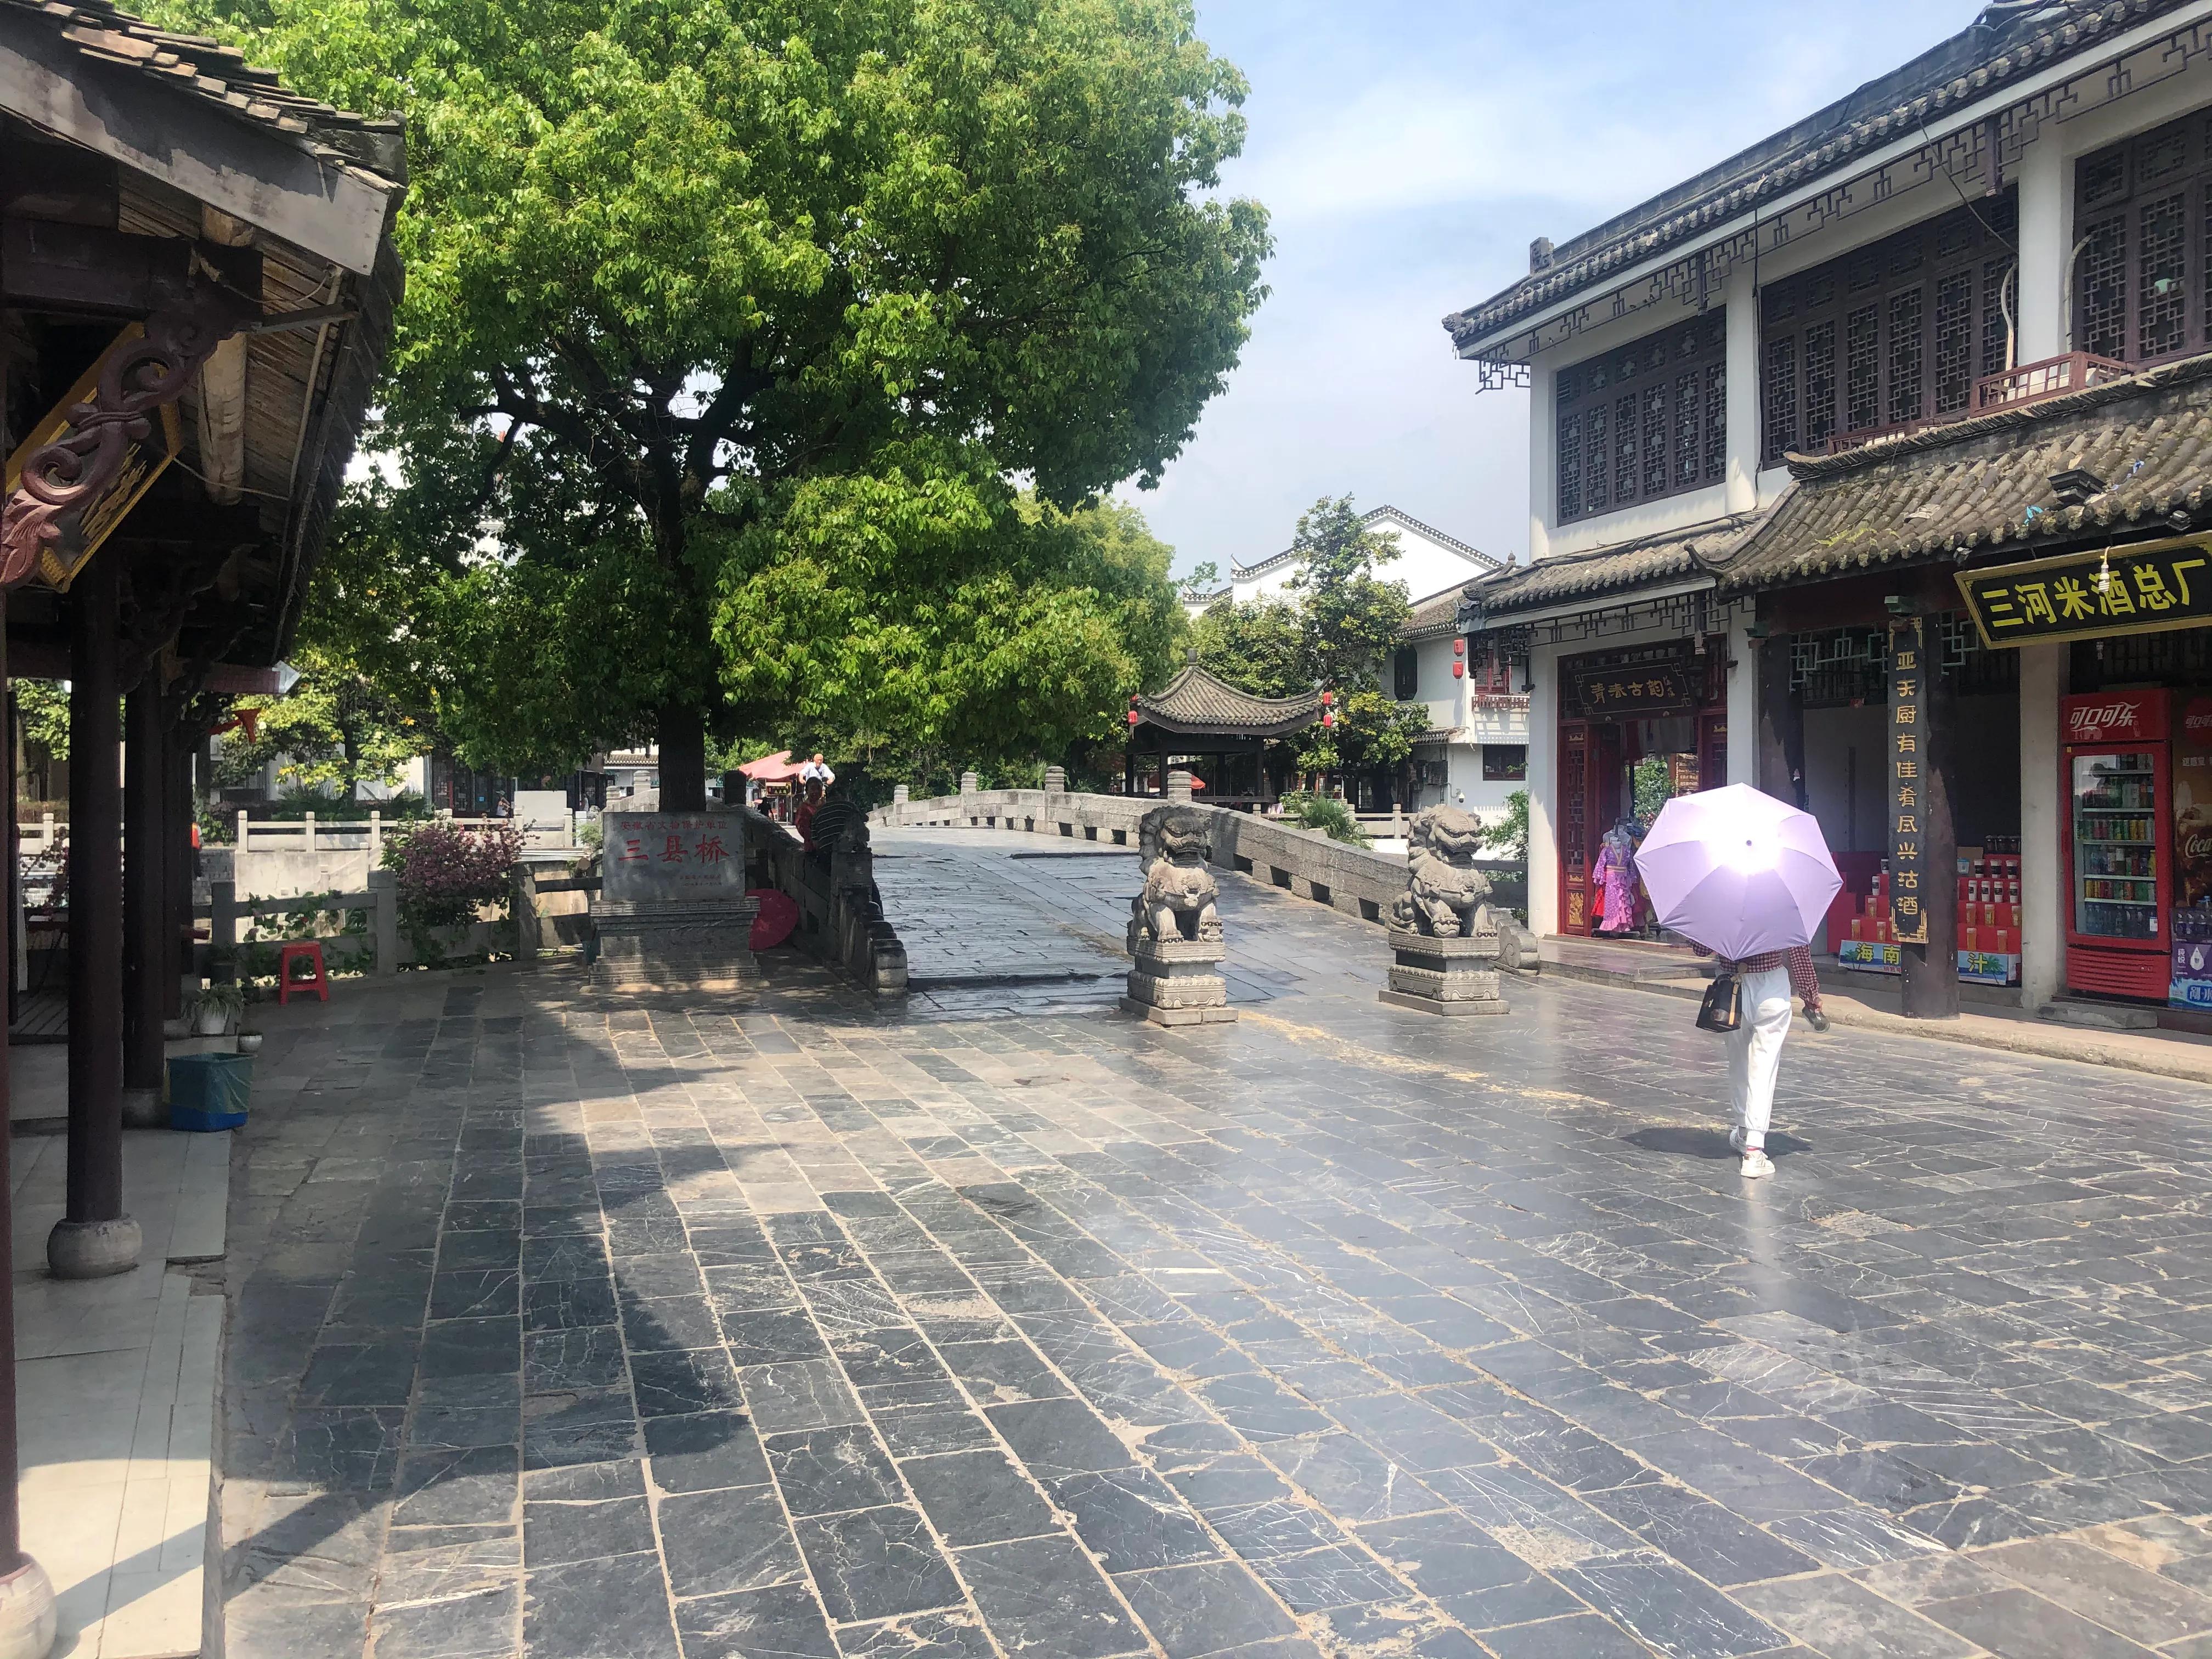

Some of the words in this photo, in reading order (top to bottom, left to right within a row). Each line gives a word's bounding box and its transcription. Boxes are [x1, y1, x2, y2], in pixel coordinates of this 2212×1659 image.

[1982, 558, 2206, 628] 三河米酒总厂
[2069, 702, 2142, 732] 可口可乐
[2186, 715, 2212, 729] 可口可
[618, 833, 730, 865] 三县桥
[1856, 943, 1901, 965] 海南
